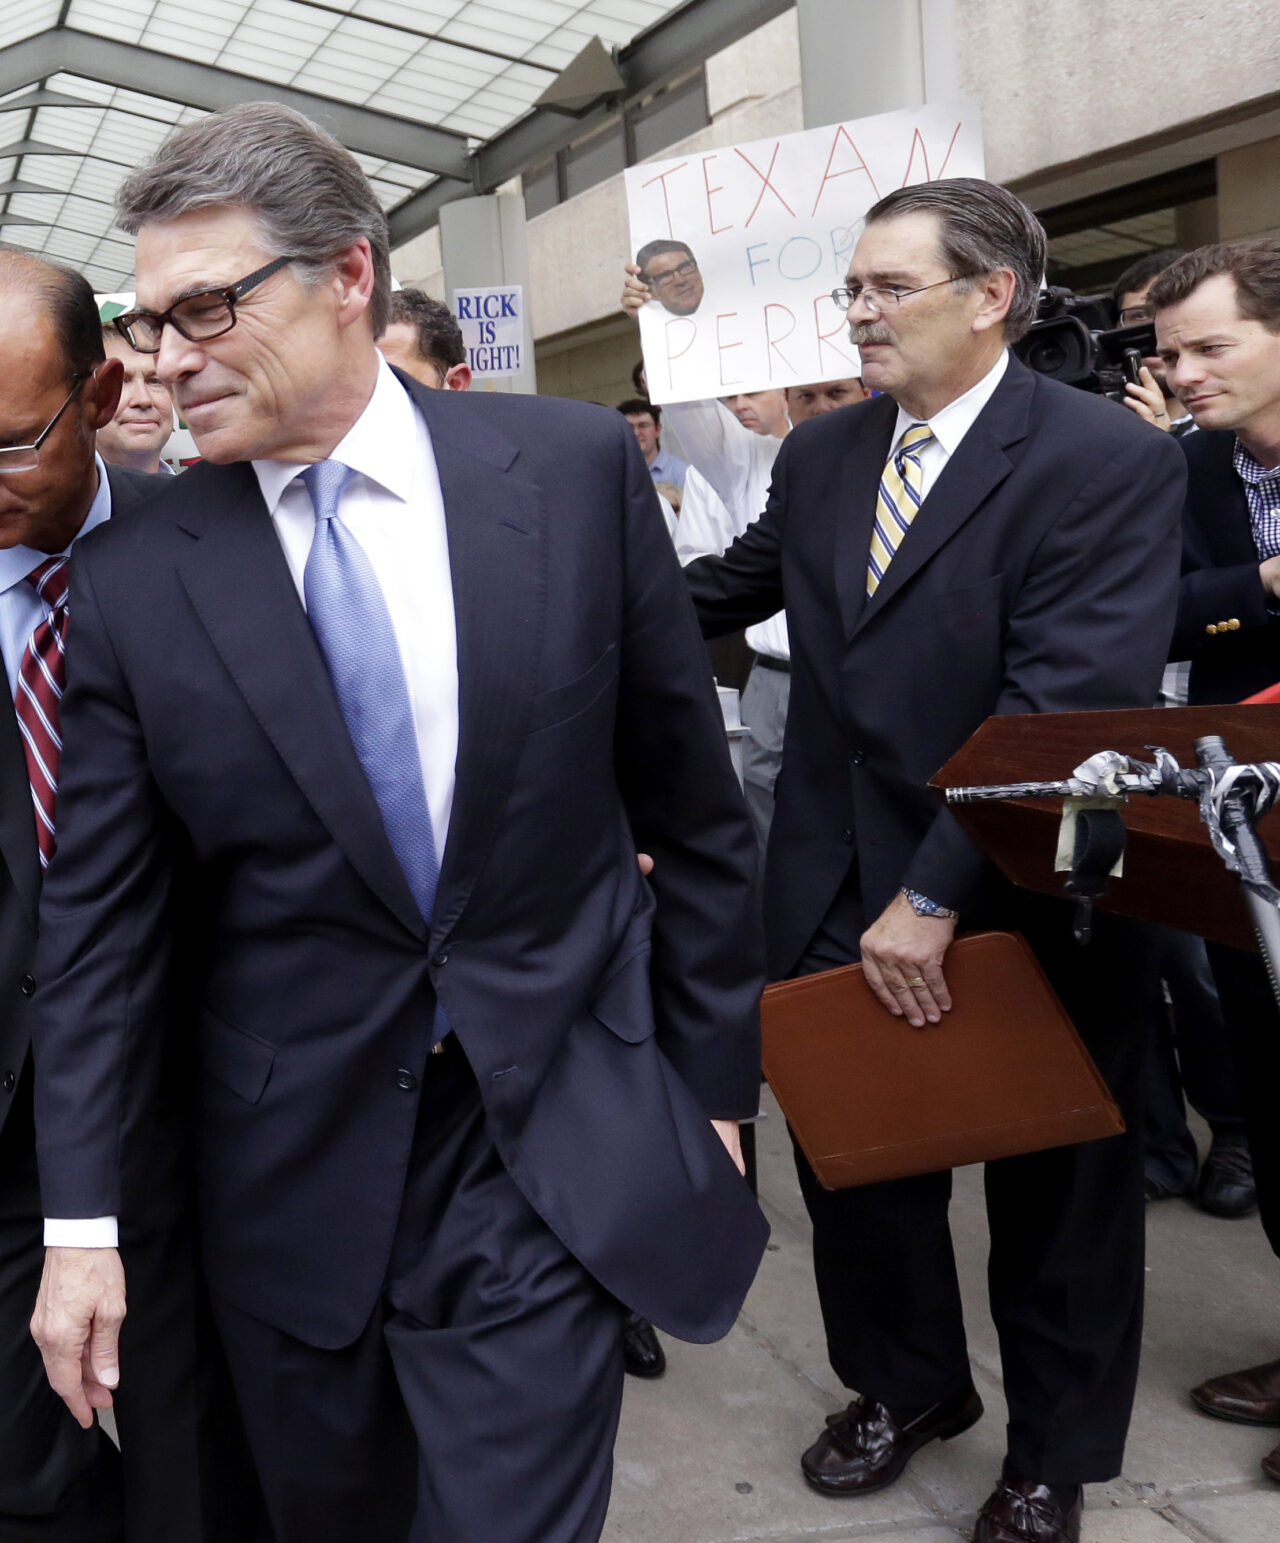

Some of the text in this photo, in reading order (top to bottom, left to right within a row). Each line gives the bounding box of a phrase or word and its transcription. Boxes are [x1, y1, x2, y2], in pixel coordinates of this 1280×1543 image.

[746, 226, 856, 287] FOR
[457, 293, 518, 320] RICK
[478, 321, 496, 345] IS
[664, 295, 859, 391] PERR
[469, 345, 520, 371] IGHT!
